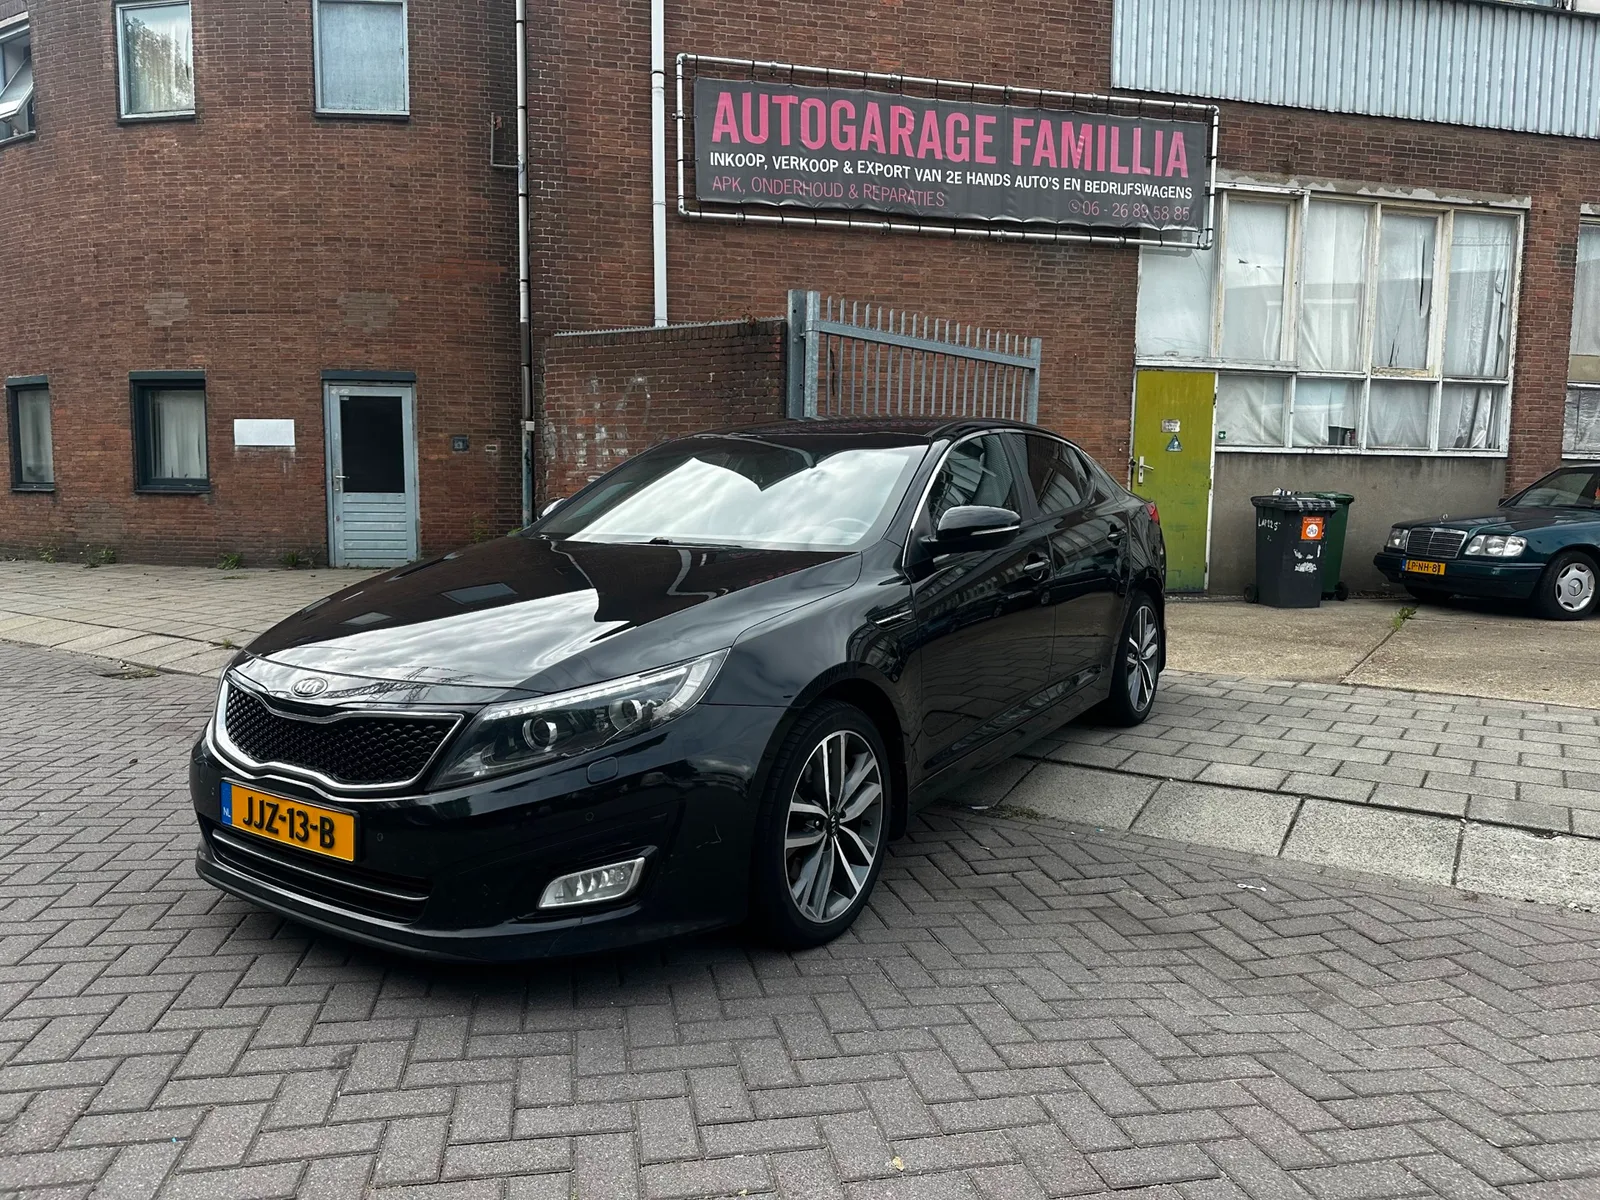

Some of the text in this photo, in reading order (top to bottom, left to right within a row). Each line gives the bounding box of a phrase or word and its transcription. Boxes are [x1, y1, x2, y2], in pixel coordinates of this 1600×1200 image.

[712, 92, 1189, 179] AUTOGARAGE FAMILLIA
[710, 152, 1193, 199] INKOOP, VERKOOP & EXPORT VAN 2E HANDS AUTO'S EN BEDRIJFSWAGENS
[712, 176, 945, 207] APK, ONDERHOUD & REPARATIES
[1082, 200, 1100, 216] 06
[1112, 202, 1129, 218] 26
[1132, 203, 1149, 219] 89
[1153, 205, 1169, 220] 58
[294, 679, 321, 693] KIA
[222, 806, 231, 818] NL
[243, 796, 335, 849] JJZ-13-B
